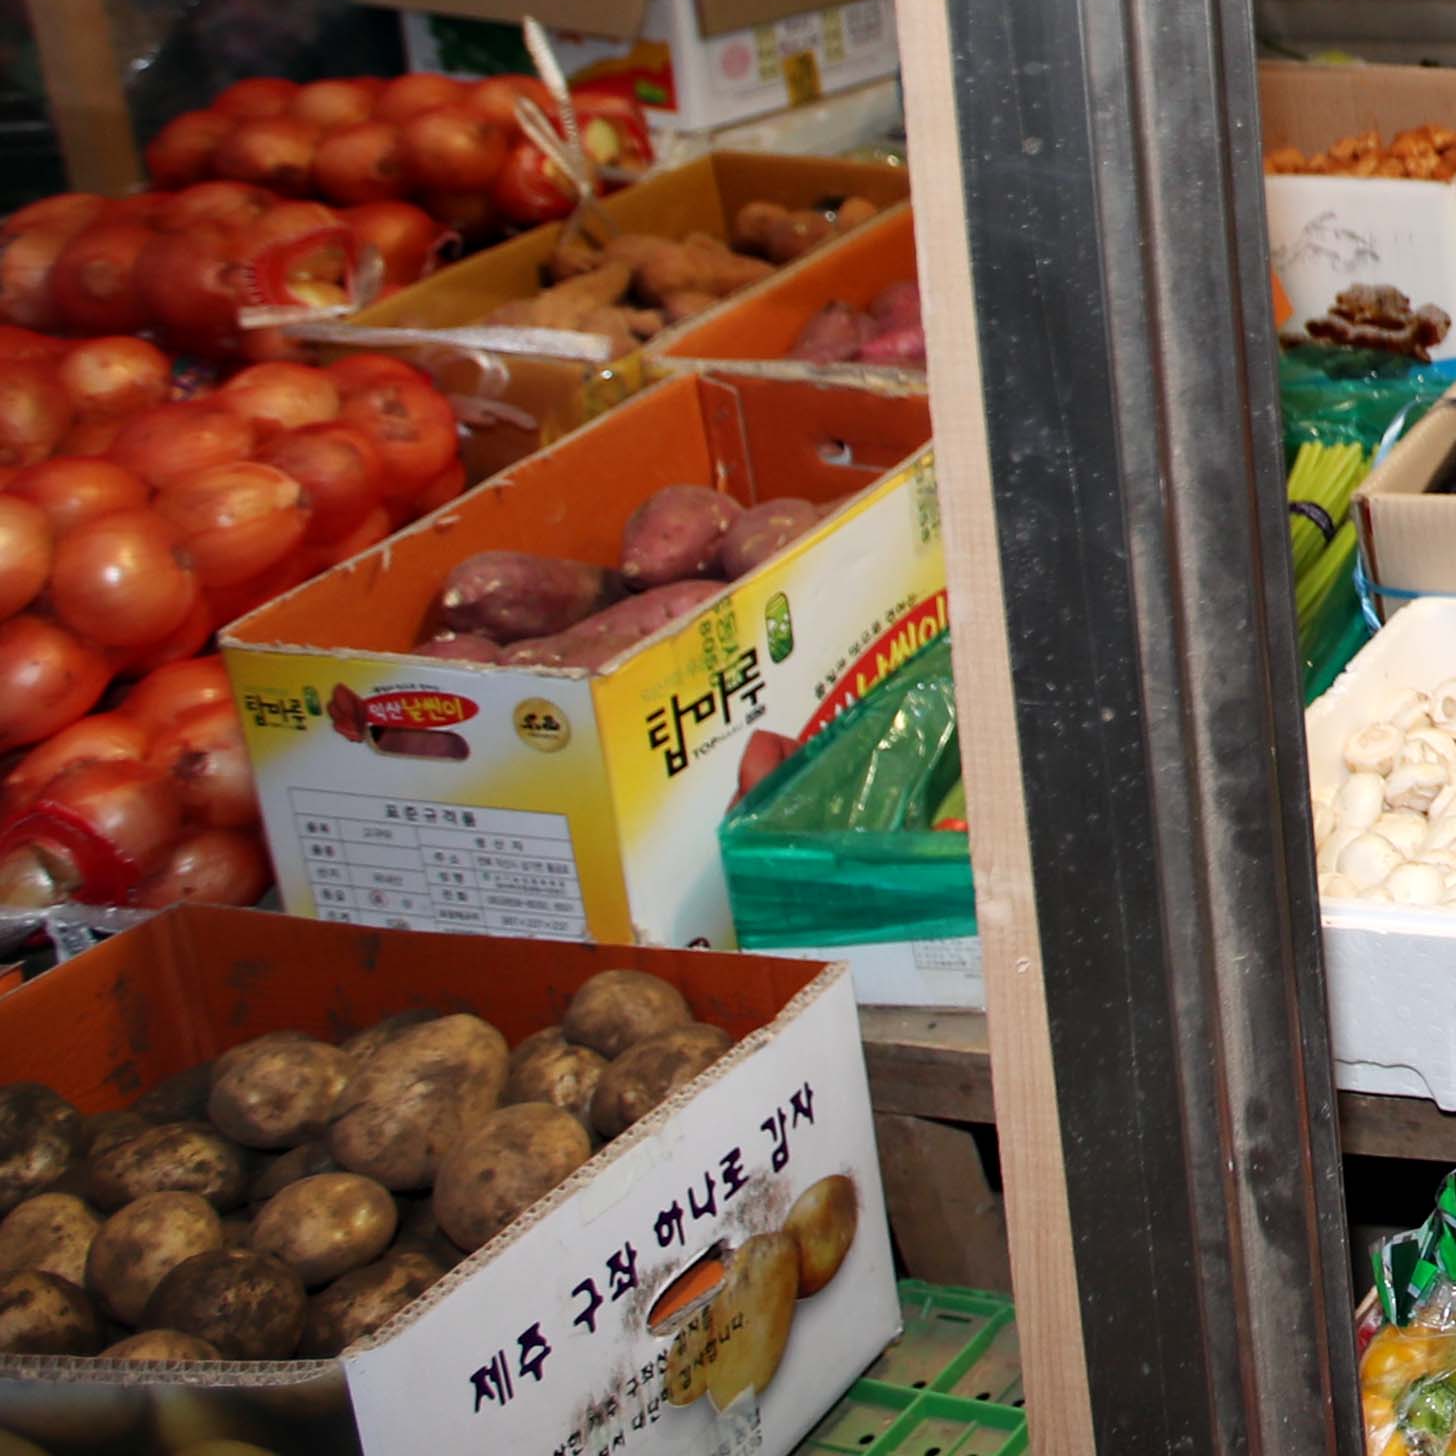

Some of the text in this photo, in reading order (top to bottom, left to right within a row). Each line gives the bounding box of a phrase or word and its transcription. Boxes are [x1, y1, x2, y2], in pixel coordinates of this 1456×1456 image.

[646, 648, 765, 777] 탑마루
[469, 1322, 552, 1413] 제주
[653, 1146, 751, 1247] 하나로
[759, 1081, 816, 1174] 감자
